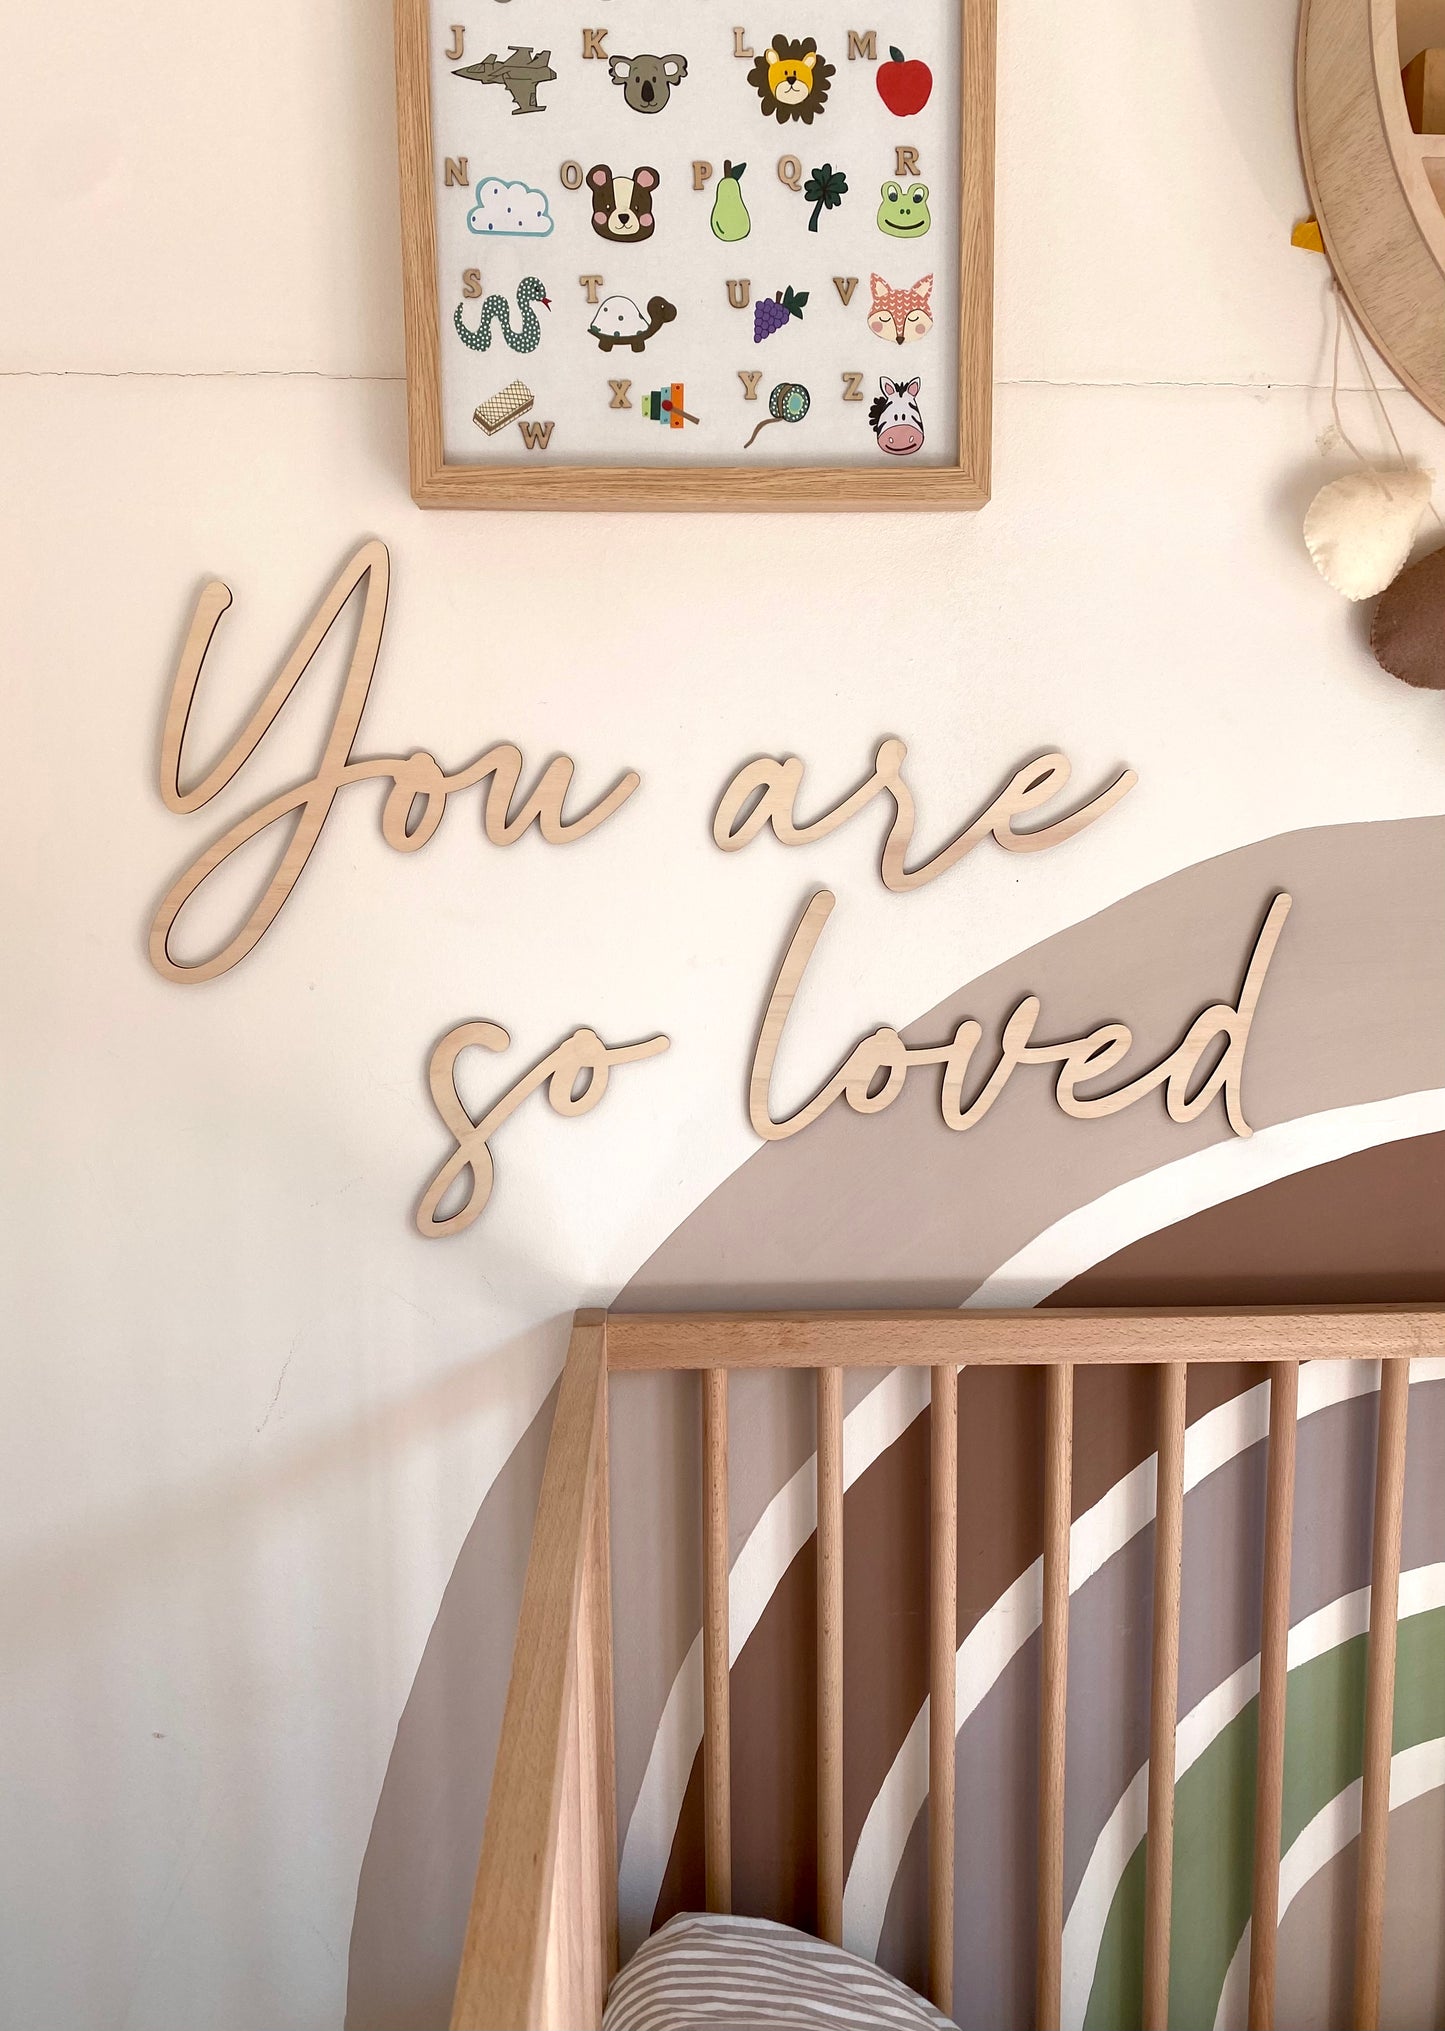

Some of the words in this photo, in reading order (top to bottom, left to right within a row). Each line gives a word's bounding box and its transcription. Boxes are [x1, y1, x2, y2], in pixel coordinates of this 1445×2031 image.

[446, 24, 466, 60] J
[582, 28, 608, 59] K
[734, 27, 754, 58] L
[848, 30, 878, 60] M
[444, 157, 469, 186] N
[560, 160, 583, 190] O
[692, 160, 712, 190] P
[778, 155, 802, 191] Q
[894, 146, 920, 176] R
[462, 268, 482, 298] S
[580, 275, 602, 304] T
[726, 279, 750, 308] U
[832, 277, 858, 306] V
[518, 421, 554, 449] W
[608, 380, 632, 408] X
[738, 372, 762, 400] Y
[842, 372, 864, 401] Z
[149, 539, 641, 985] You
[713, 739, 1138, 892] are
[416, 1021, 671, 1239] so
[749, 890, 1292, 1141] loved
